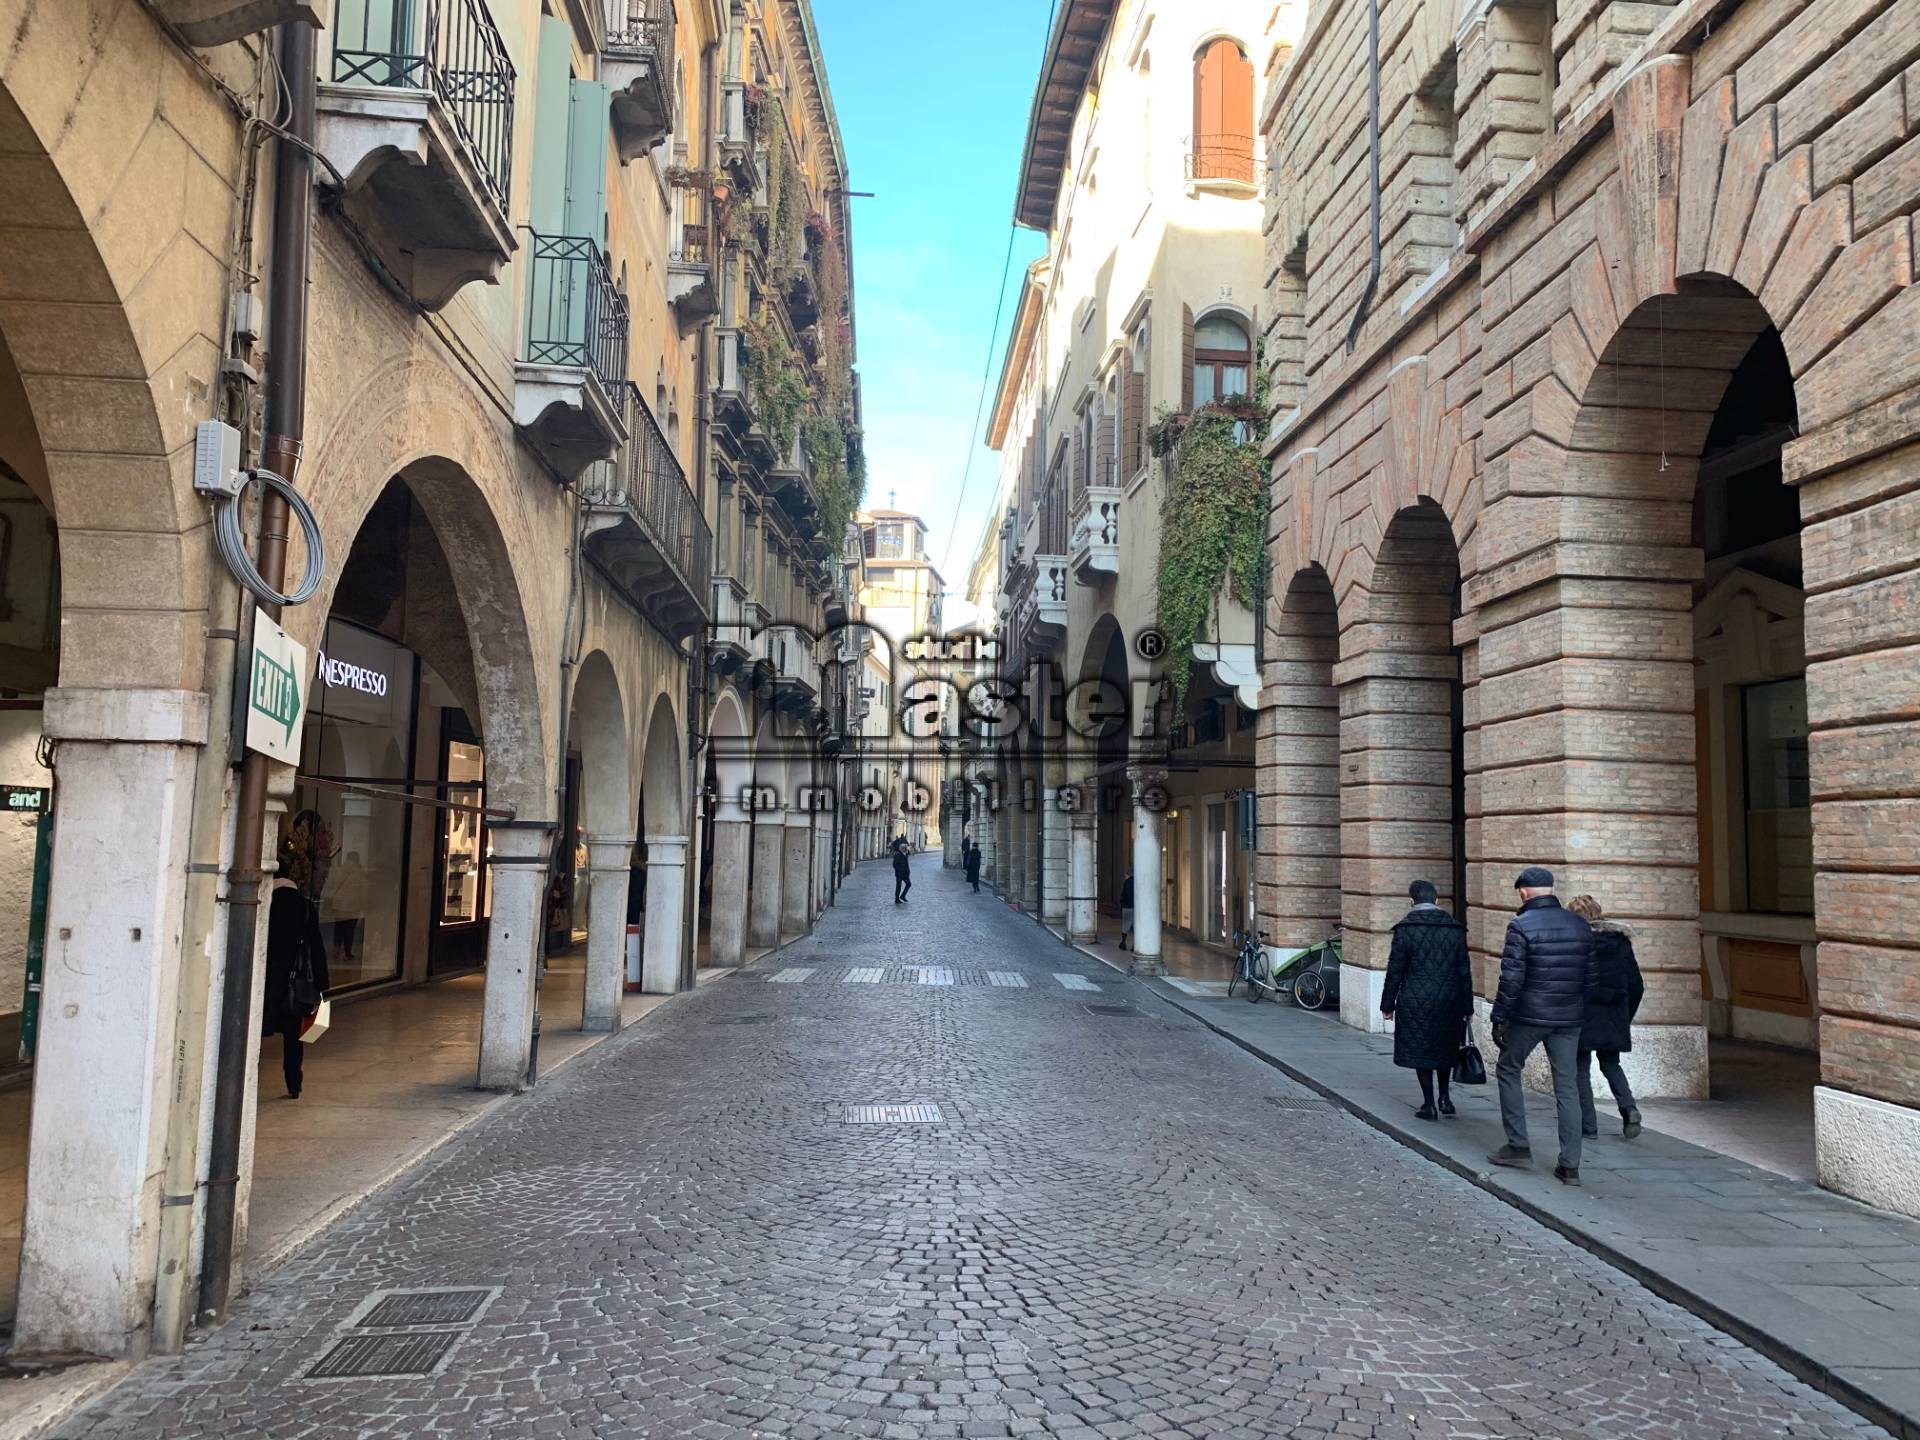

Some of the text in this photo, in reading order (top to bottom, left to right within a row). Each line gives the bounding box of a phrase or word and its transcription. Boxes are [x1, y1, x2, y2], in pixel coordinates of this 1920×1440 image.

[256, 656, 285, 717] EXIT
[318, 650, 387, 696] NESPRESSO
[8, 790, 41, 808] and
